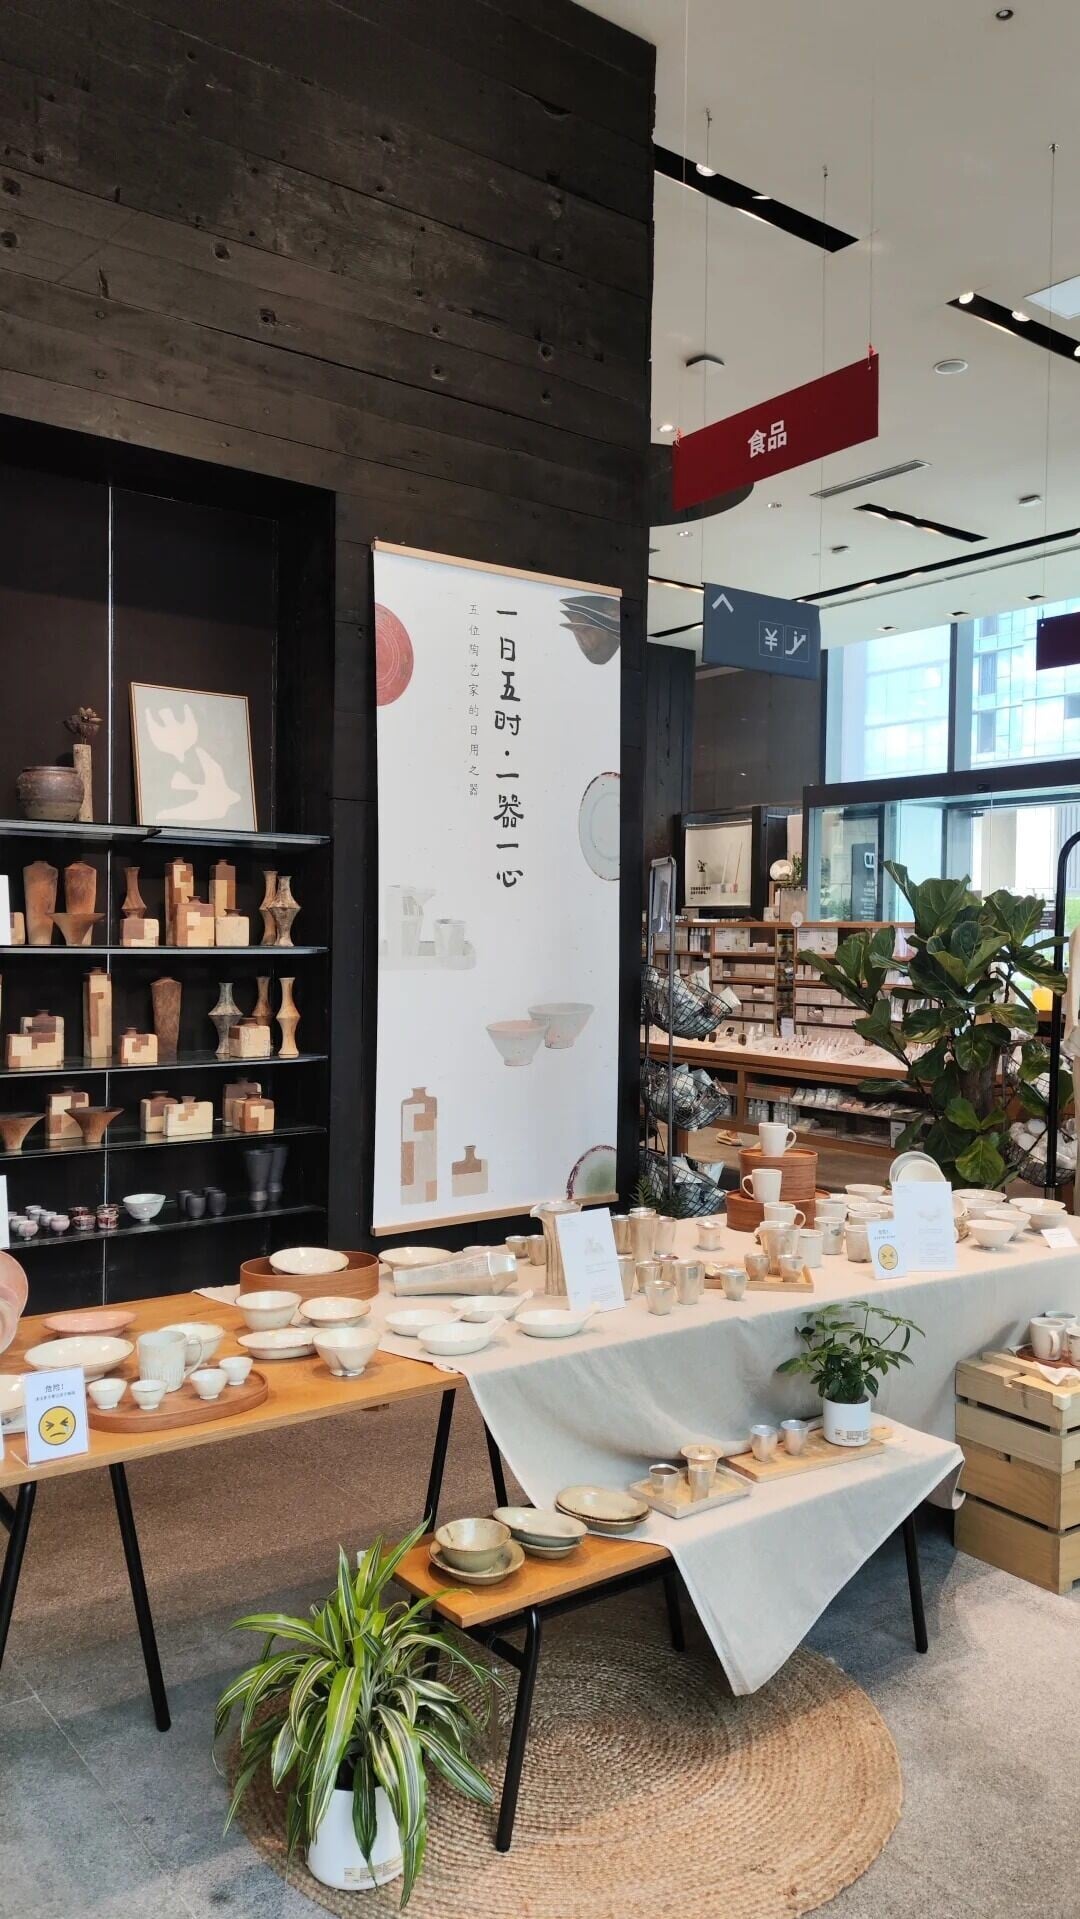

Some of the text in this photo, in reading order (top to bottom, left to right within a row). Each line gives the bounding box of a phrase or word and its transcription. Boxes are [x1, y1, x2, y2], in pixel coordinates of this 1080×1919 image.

[747, 419, 788, 459] 食品
[467, 603, 481, 797] 五位陶艺家的日用之器
[493, 608, 524, 888] 一日五时·一器一心
